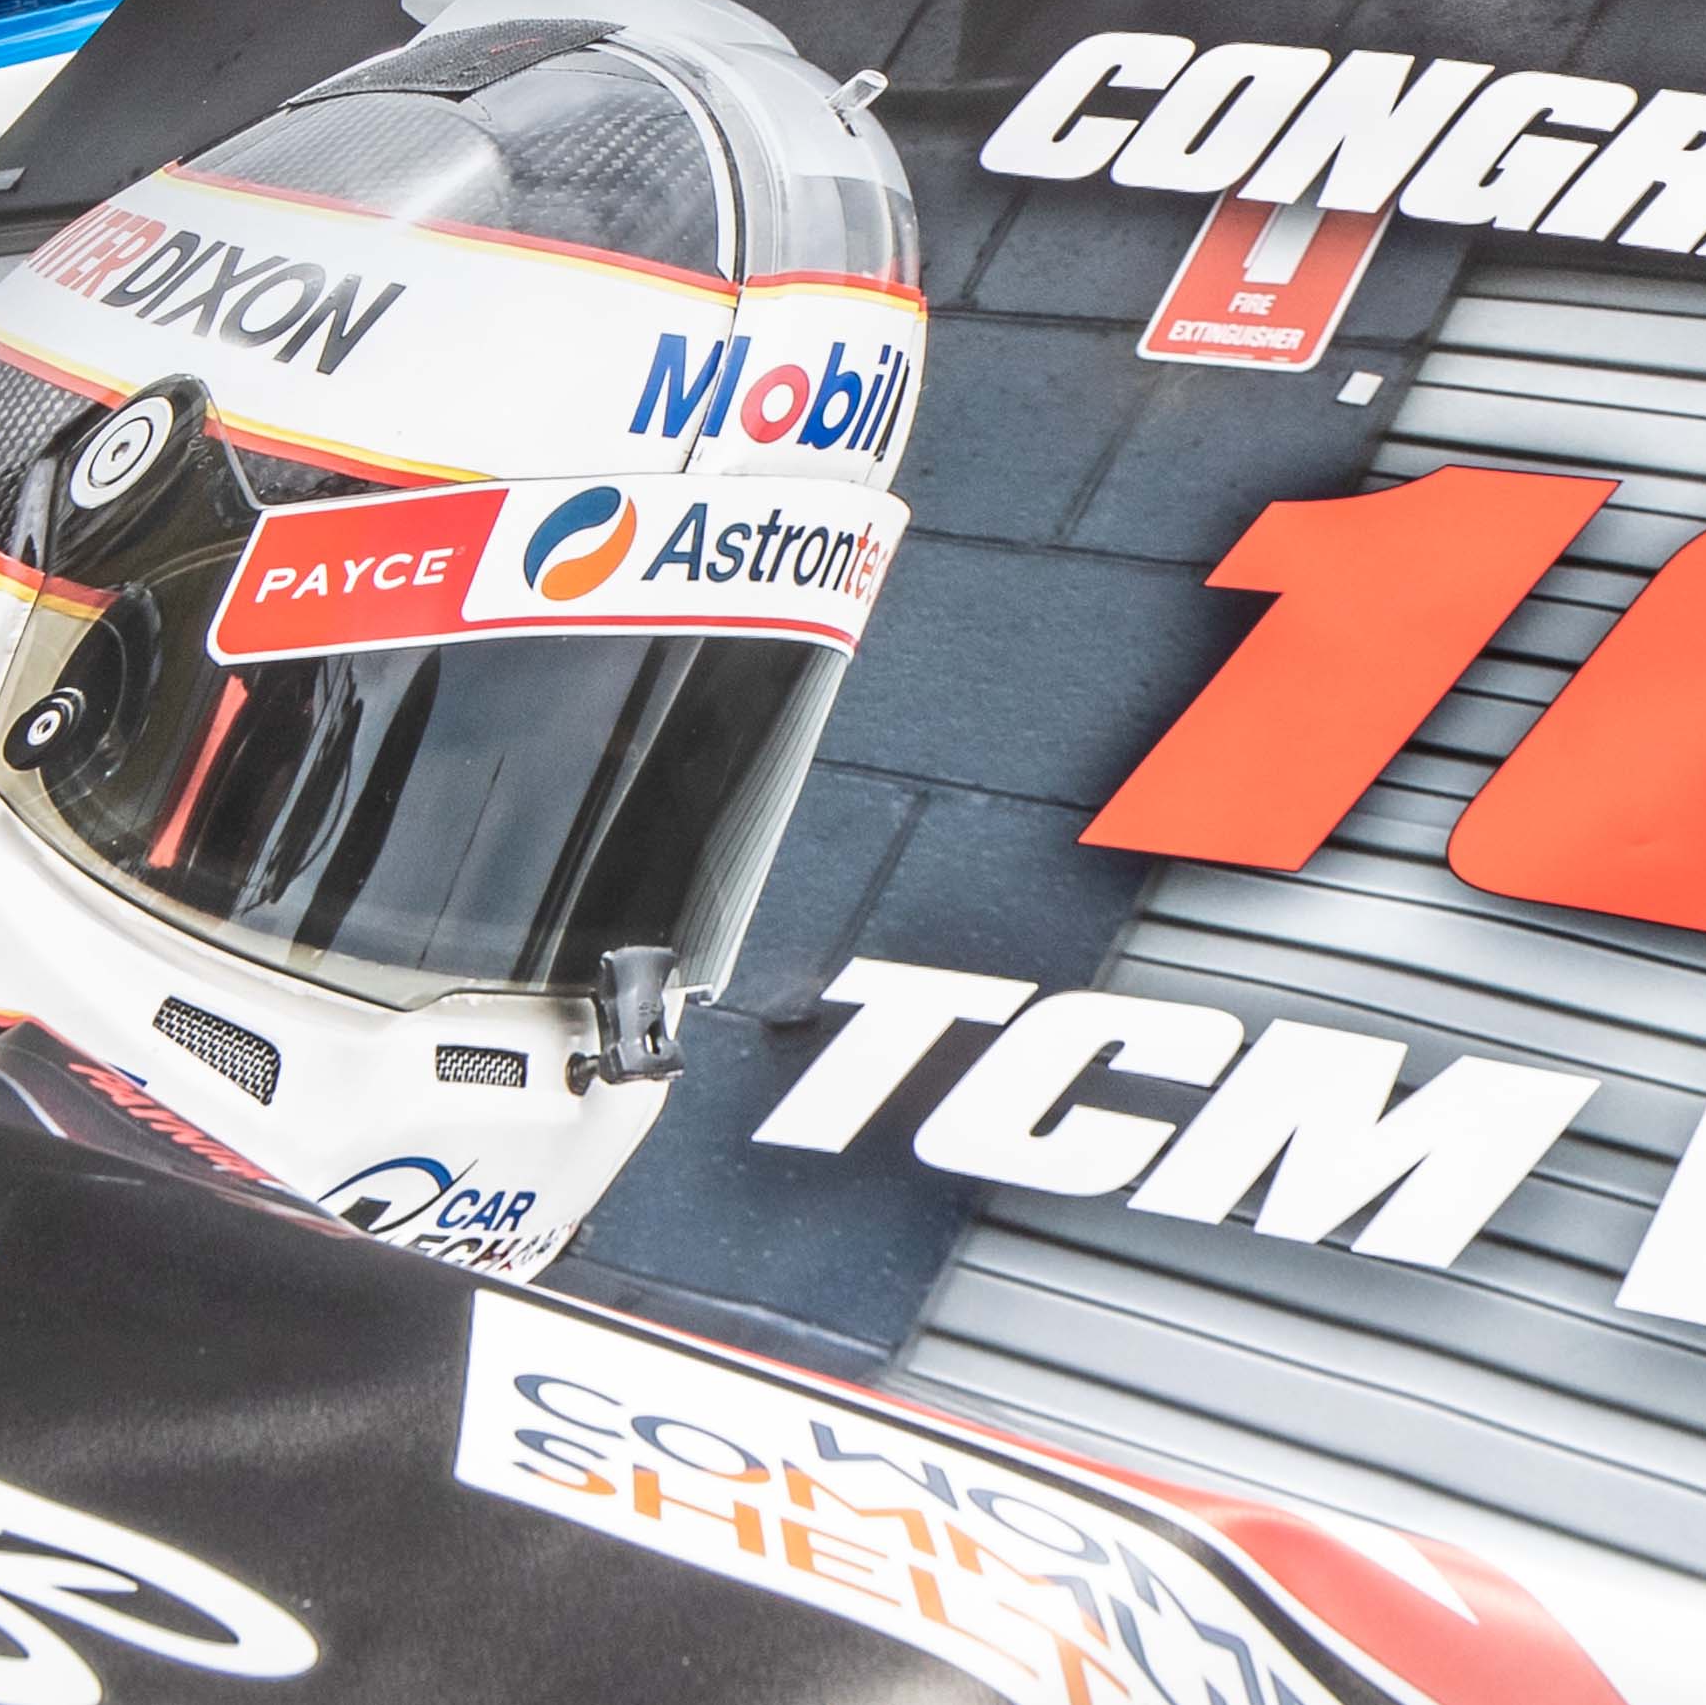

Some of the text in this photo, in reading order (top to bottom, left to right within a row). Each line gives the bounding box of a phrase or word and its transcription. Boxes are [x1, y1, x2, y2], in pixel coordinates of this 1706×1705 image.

[100, 229, 407, 375] DIXON
[1167, 319, 1305, 351] EXTINGUISHER
[1227, 290, 1278, 316] FIRE
[628, 332, 904, 451] Mobil
[253, 501, 890, 606] PAYCE Astronte
[751, 956, 1602, 1270] TCM
[435, 1188, 537, 1232] CAR
